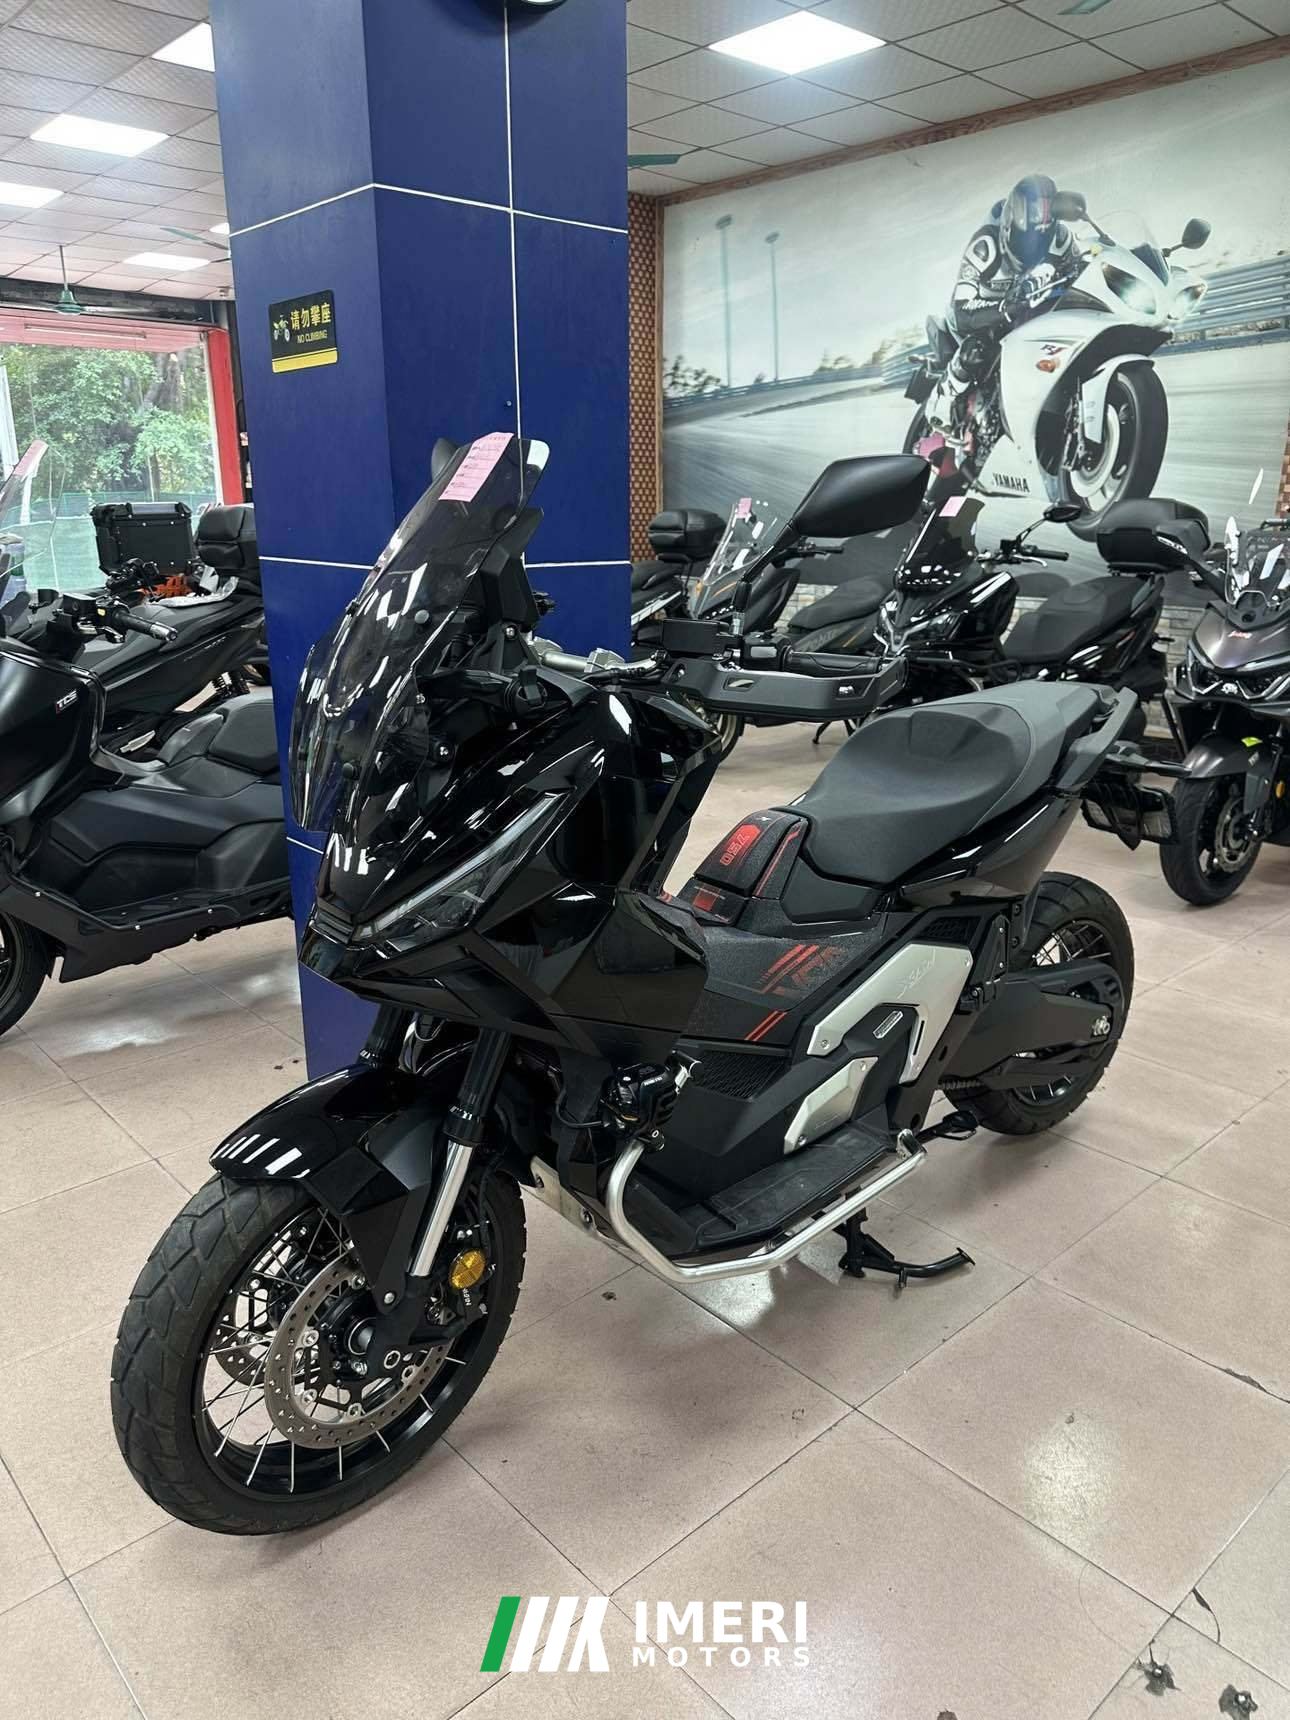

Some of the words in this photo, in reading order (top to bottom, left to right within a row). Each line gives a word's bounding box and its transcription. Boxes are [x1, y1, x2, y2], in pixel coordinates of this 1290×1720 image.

[290, 302, 332, 330] 请勿攀座
[297, 334, 305, 344] NO
[305, 329, 328, 342] CLIMBING
[992, 472, 1031, 492] YAMAHA
[719, 833, 751, 866] 750
